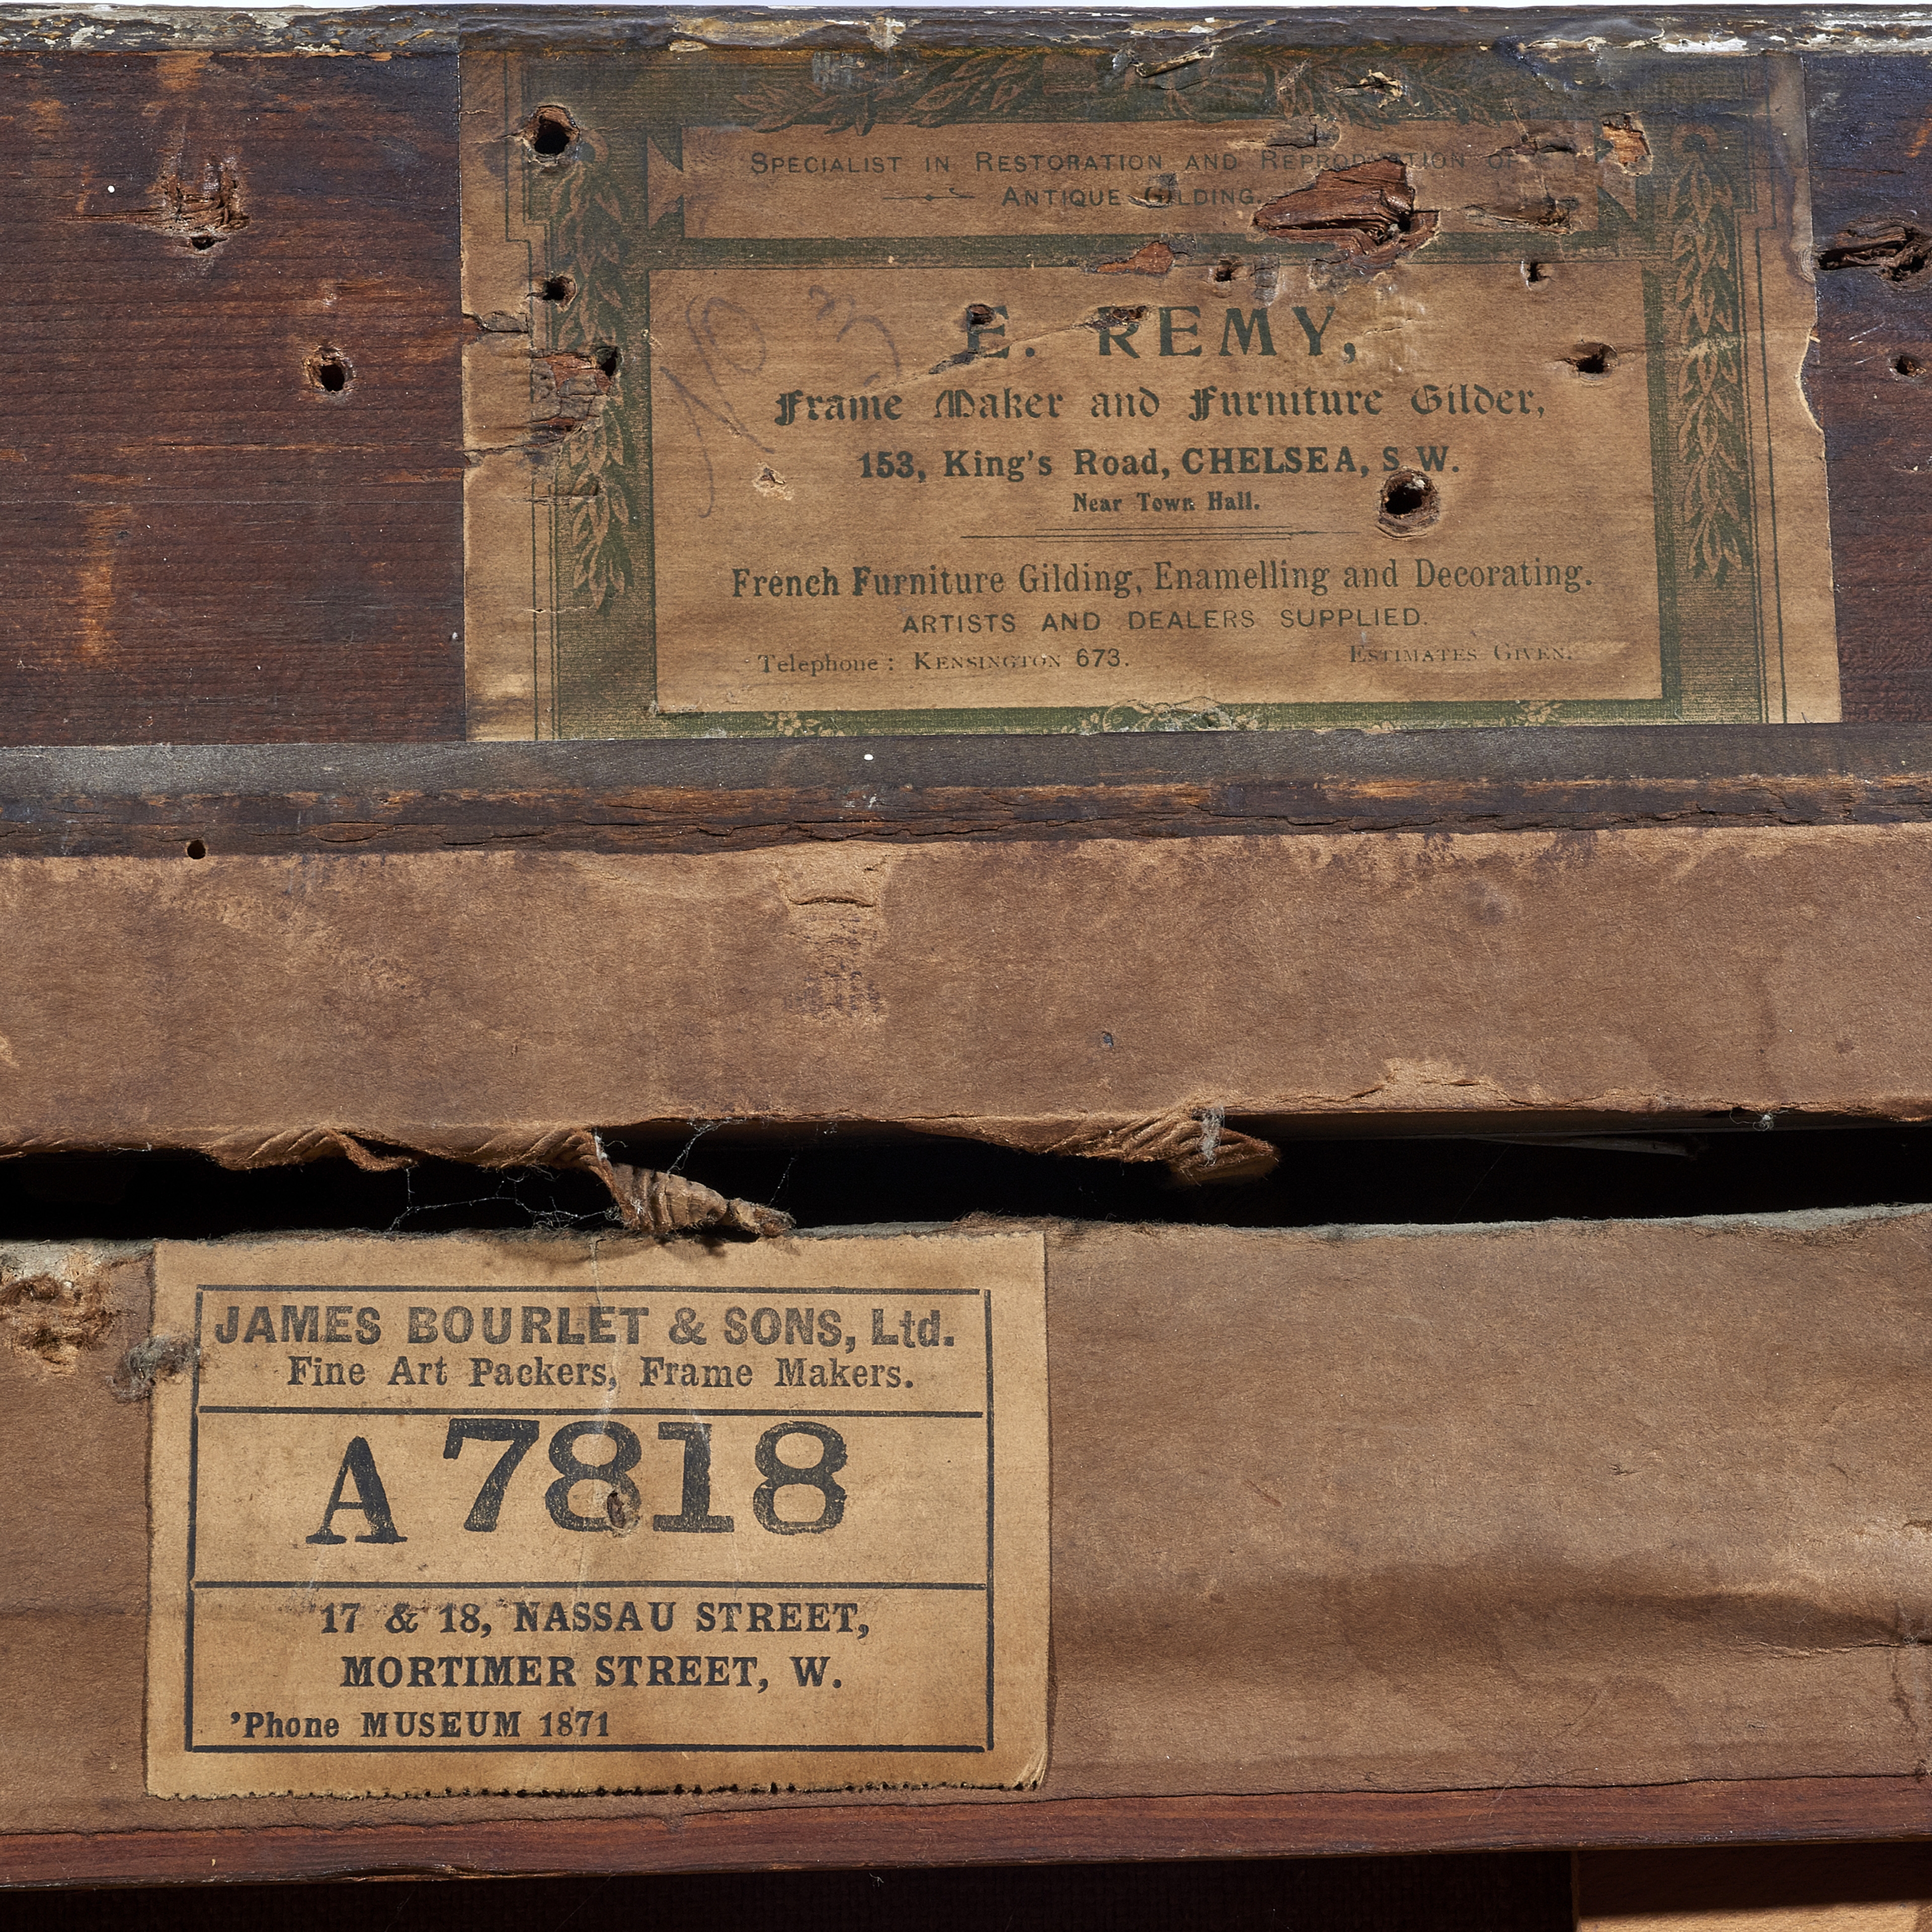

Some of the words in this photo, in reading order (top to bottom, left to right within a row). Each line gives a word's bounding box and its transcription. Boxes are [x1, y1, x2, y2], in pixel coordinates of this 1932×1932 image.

[751, 152, 902, 175] SPECIALIST
[926, 156, 949, 172] IN
[976, 152, 1161, 173] RESTORATION
[1185, 154, 1237, 171] AND
[1002, 187, 1120, 207] ANTIQUE
[967, 305, 1035, 359] E.
[1097, 303, 1357, 365] REMY,
[774, 389, 902, 426] Frame
[934, 388, 1063, 418] Maker
[1091, 387, 1159, 417] and
[1188, 385, 1383, 421] Furniture
[1411, 384, 1544, 418] Gilder,
[857, 451, 926, 483] 153,
[943, 450, 1053, 482] King's
[1074, 448, 1169, 479] Road,
[1181, 446, 1369, 478] CHELSEA,
[1073, 493, 1122, 512] Near
[1136, 493, 1195, 512] Town
[1208, 491, 1259, 510] Hall.
[733, 567, 840, 597] French
[852, 565, 1004, 596] Furniture
[1016, 559, 1143, 600] Gilding,
[1155, 559, 1330, 596] Enamelling
[1344, 559, 1398, 588] and
[1415, 557, 1592, 593] Decorating.
[903, 613, 1015, 633] ARTISTS
[1042, 612, 1100, 631] AND
[1129, 610, 1254, 630] DEALERS
[1281, 608, 1428, 628] SUPPLIED.
[915, 652, 1060, 670] KENSINGTON
[1077, 648, 1130, 667] 673.
[1350, 642, 1476, 662] ESTIMATES
[1494, 643, 1571, 660] GIVEN.
[215, 1305, 381, 1345] JAMES
[408, 1306, 649, 1345] BOURLET
[669, 1308, 706, 1345] &
[724, 1307, 855, 1354] SONS,
[872, 1309, 954, 1348] Ltd.
[287, 1356, 365, 1386] Fine
[388, 1356, 447, 1385] Art
[469, 1356, 616, 1391] Packers,
[640, 1356, 752, 1387] Frame
[775, 1358, 913, 1388] Makers.
[306, 1436, 408, 1545] A
[443, 1418, 848, 1535] 7818
[320, 1602, 360, 1633] 17
[385, 1602, 420, 1633] &
[439, 1603, 492, 1638] 18,
[513, 1600, 676, 1632] NASSAU
[697, 1602, 869, 1639] STREET,
[340, 1656, 576, 1688] MORTIMER
[596, 1656, 768, 1693] STREET,
[790, 1656, 841, 1688] W.
[361, 1711, 521, 1737] MUSEUM
[540, 1710, 608, 1737] 1871
